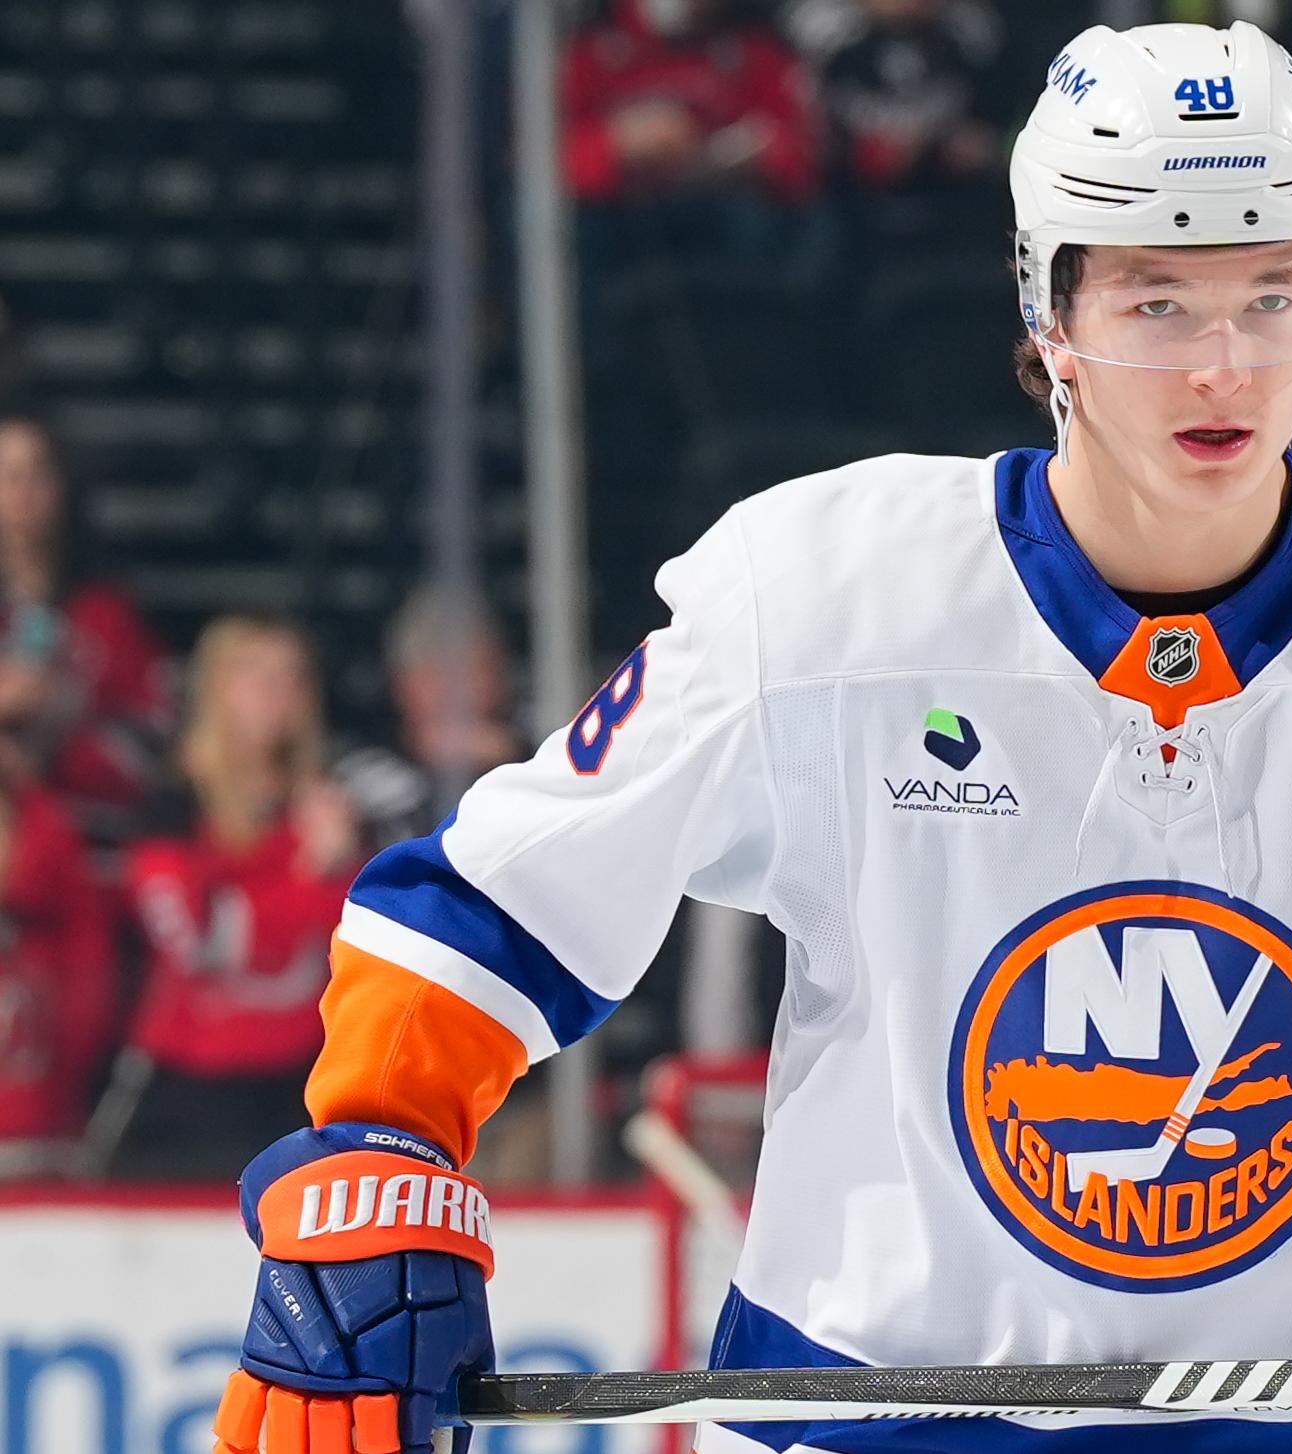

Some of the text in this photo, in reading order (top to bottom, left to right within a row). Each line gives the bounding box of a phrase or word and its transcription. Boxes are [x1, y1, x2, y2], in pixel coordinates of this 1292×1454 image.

[1174, 76, 1234, 111] 48
[1163, 155, 1267, 171] WARRIOR
[1157, 642, 1189, 673] NHL
[883, 777, 1019, 806] VANDA
[893, 803, 998, 816] PHARMACEUTICALS
[1043, 924, 1275, 1112] NY
[297, 1173, 493, 1246] WARR
[269, 1269, 305, 1322] COVERT
